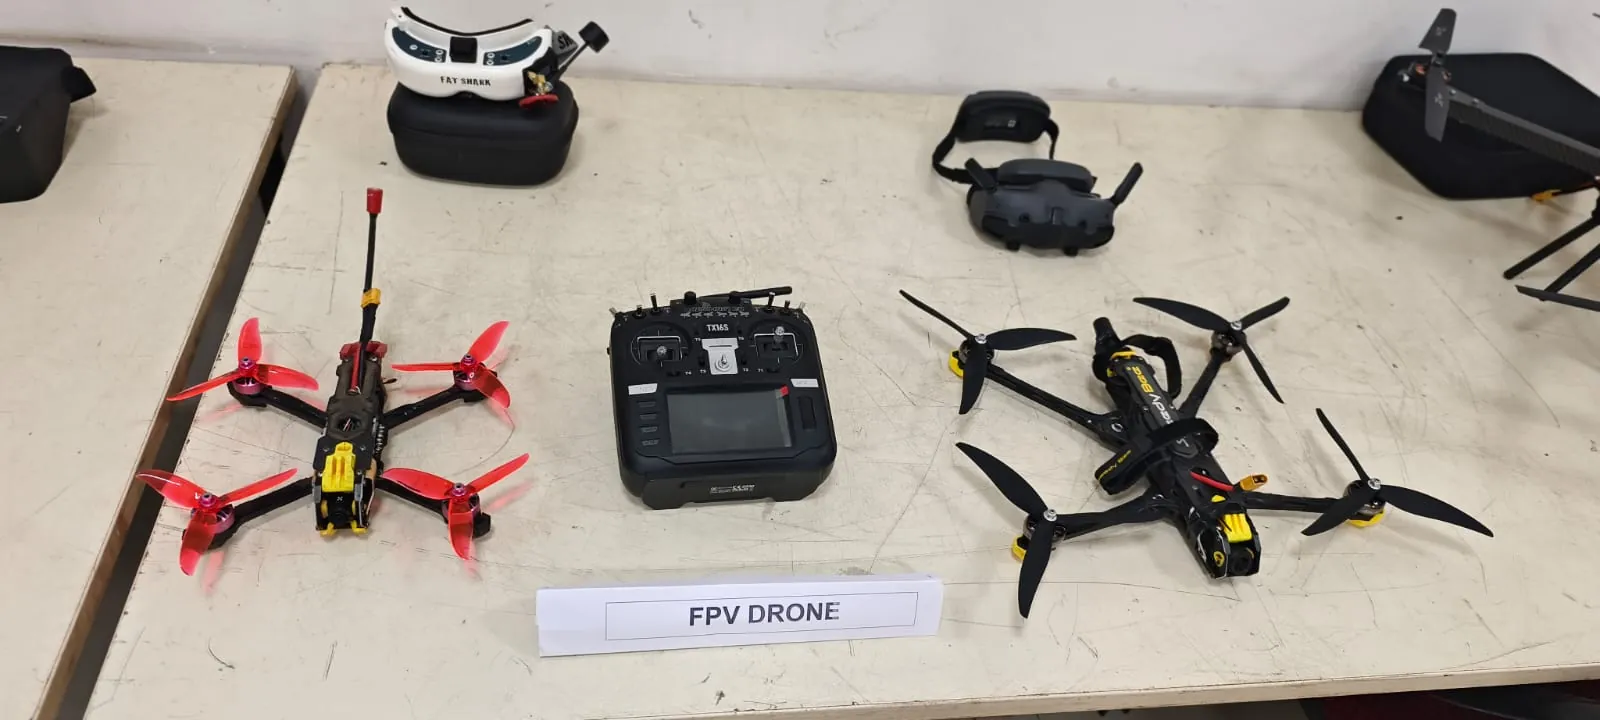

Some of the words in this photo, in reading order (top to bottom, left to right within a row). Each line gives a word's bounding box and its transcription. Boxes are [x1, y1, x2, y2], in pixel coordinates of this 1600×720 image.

[440, 76, 458, 84] FAT
[460, 77, 491, 86] SHARK
[706, 323, 729, 332] TX16S
[689, 605, 740, 626] FPV
[748, 602, 840, 624] DRONE
